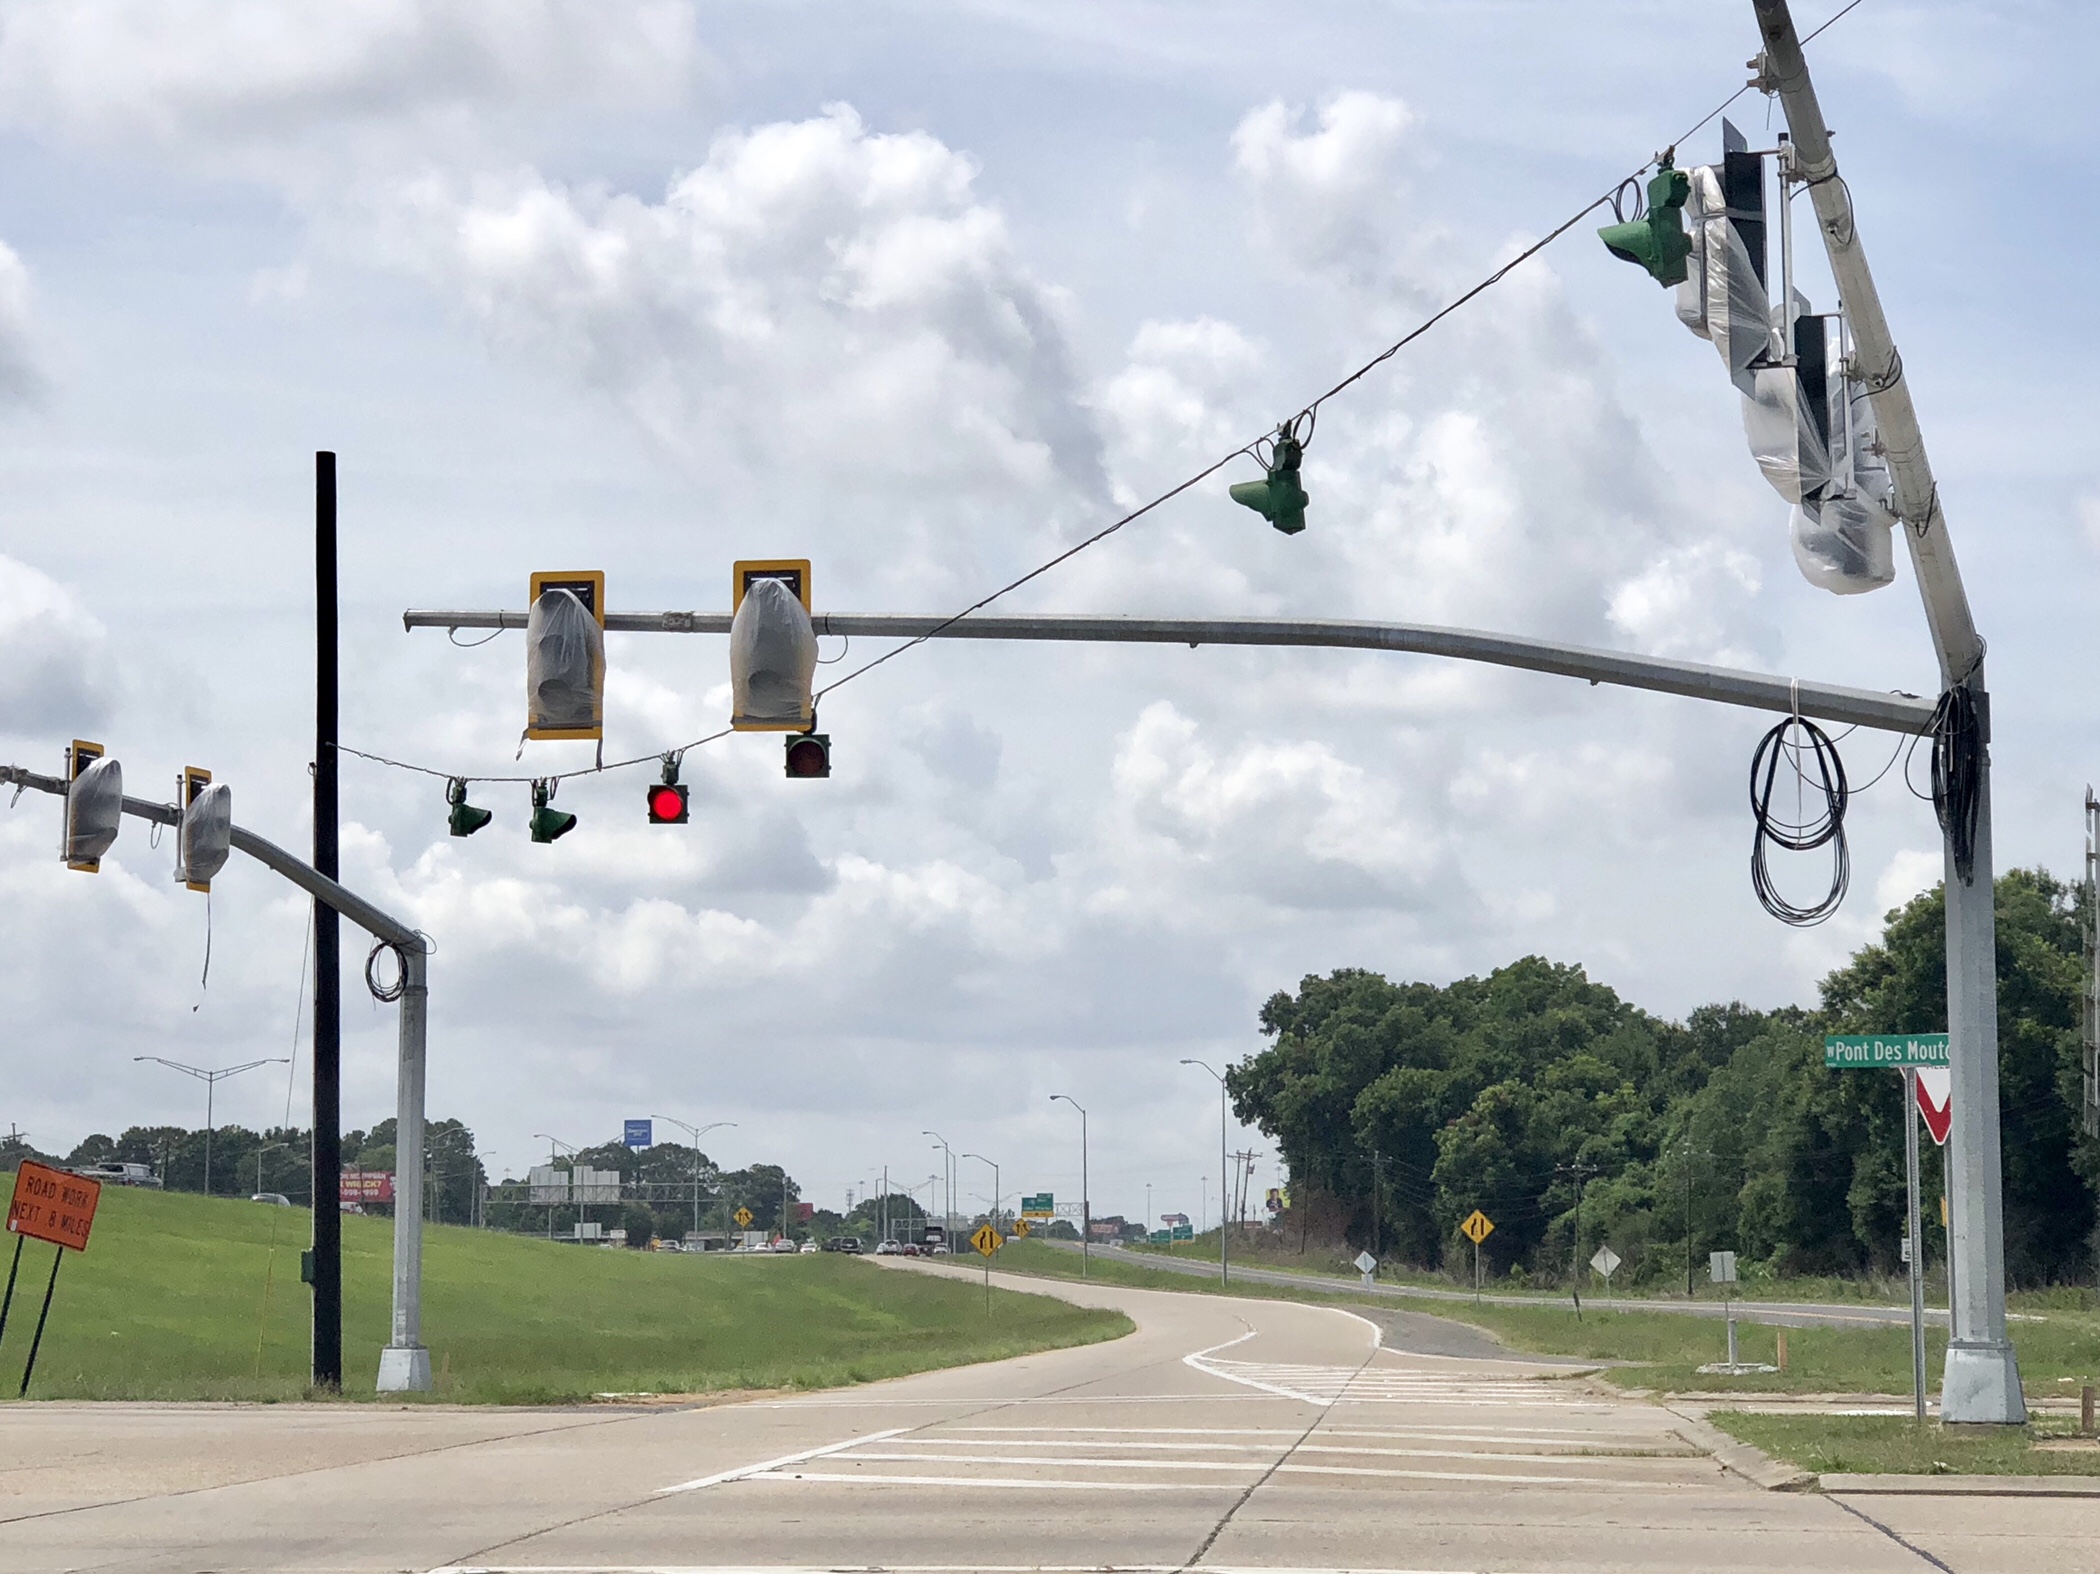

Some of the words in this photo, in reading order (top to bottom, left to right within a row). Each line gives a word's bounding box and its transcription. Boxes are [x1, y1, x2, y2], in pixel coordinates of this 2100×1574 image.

[1827, 1045, 1834, 1057] W
[1836, 1041, 1869, 1061] Pont
[1874, 1041, 1902, 1060] Des
[25, 1176, 57, 1199] ROAD
[61, 1186, 89, 1209] WORK
[11, 1200, 41, 1222] NEXT
[48, 1210, 57, 1228] 8
[61, 1214, 90, 1237] MILES
